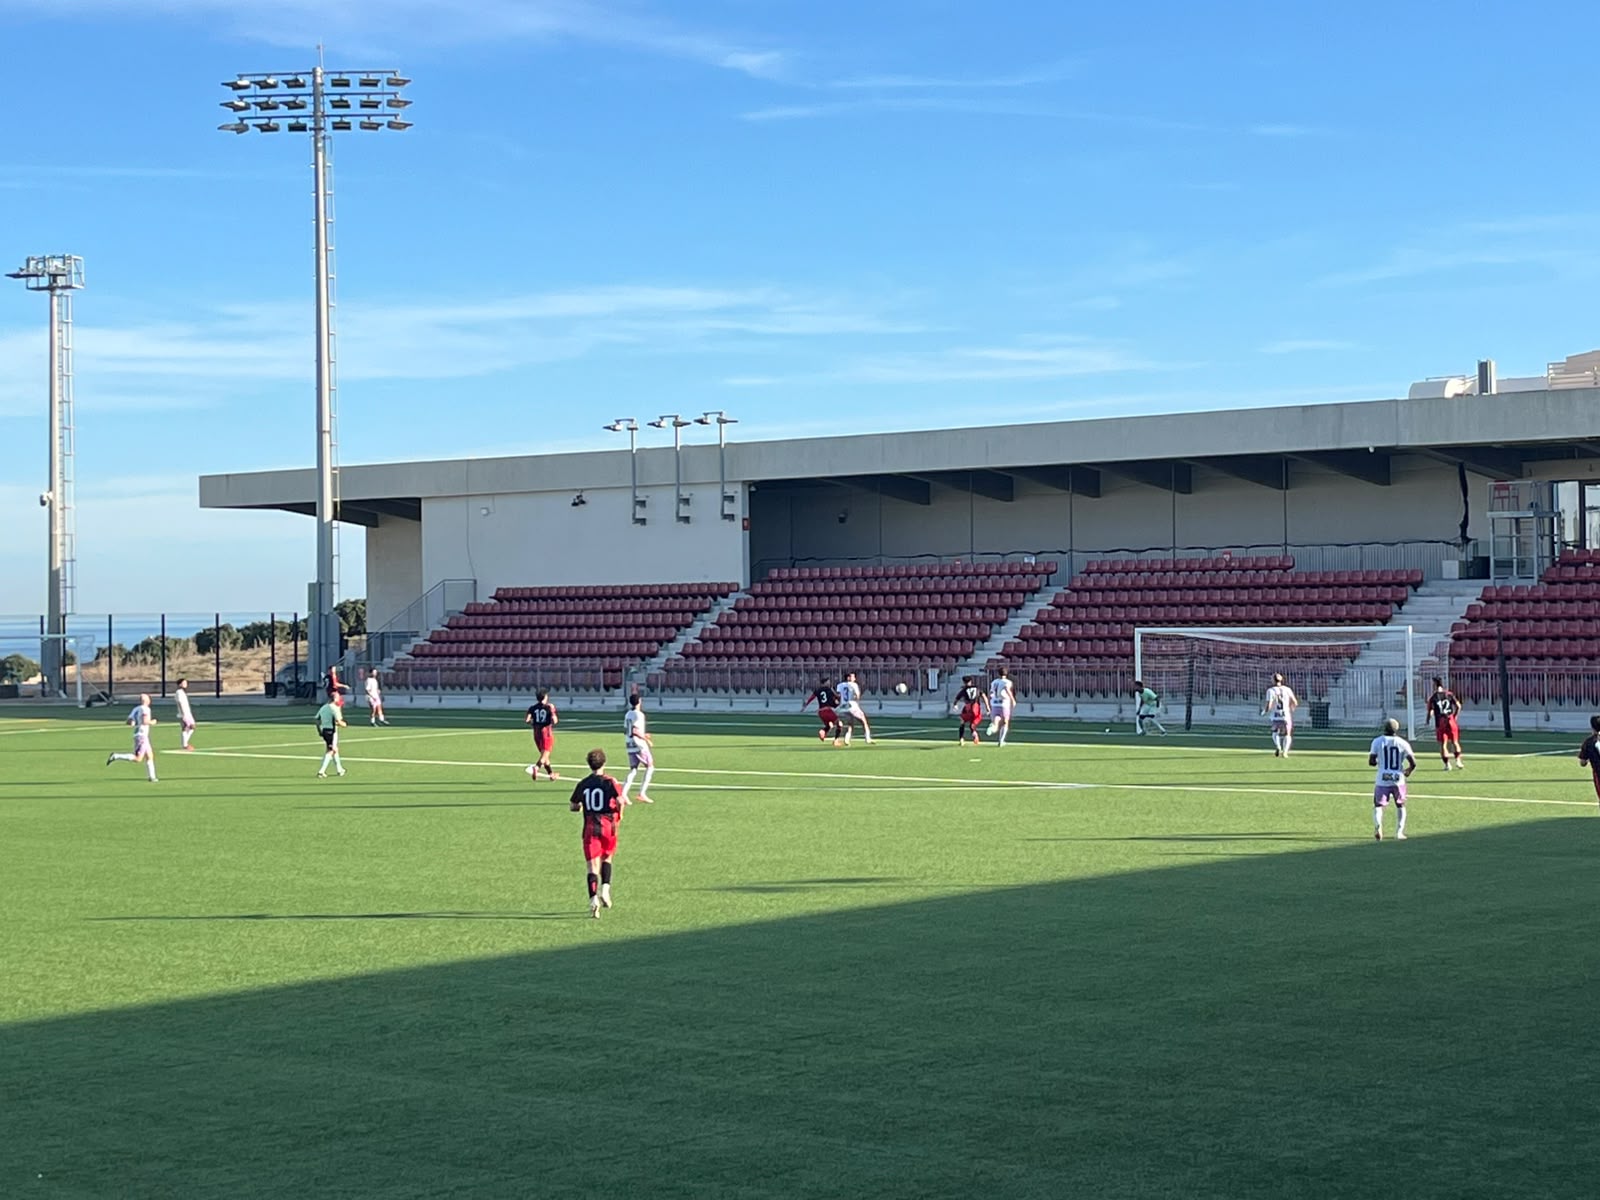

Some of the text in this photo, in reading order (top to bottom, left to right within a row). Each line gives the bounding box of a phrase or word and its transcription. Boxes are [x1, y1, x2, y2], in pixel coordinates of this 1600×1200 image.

[820, 691, 828, 703] 3
[843, 687, 849, 702] 3
[1436, 699, 1451, 714] 12
[534, 708, 547, 722] 19
[1383, 745, 1399, 770] 10
[583, 787, 604, 811] 10
